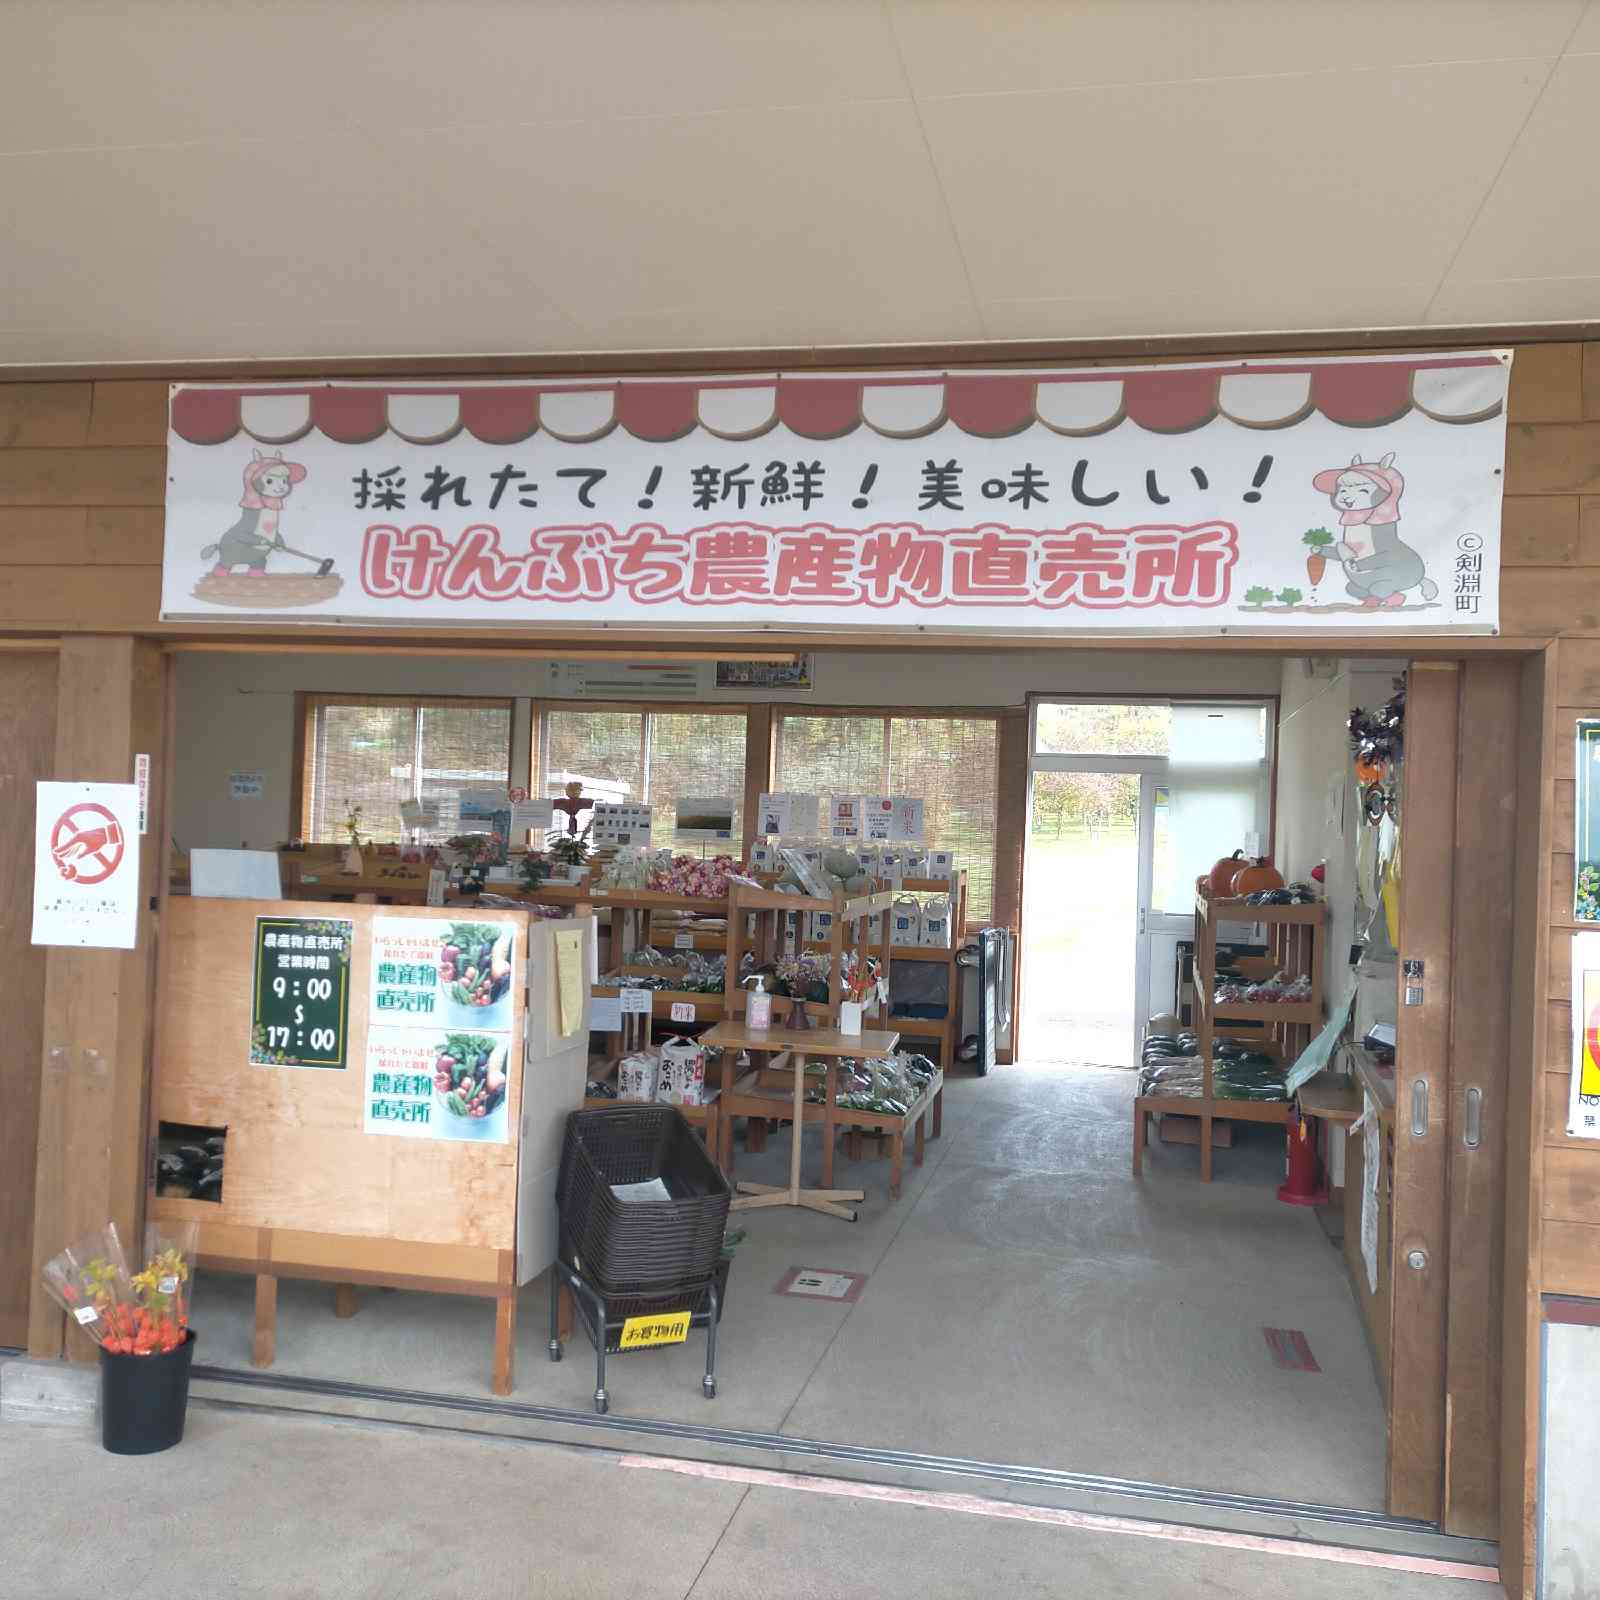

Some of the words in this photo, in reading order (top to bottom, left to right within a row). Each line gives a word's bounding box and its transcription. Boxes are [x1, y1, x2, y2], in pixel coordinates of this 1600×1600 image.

[361, 520, 1239, 608] けんぶち農産物直売所
[264, 933, 344, 951] 農産物直売所
[277, 954, 330, 970] 営業時間
[378, 962, 437, 987] 農産物
[376, 989, 435, 1014] 直売所
[373, 1073, 432, 1098] 農産物
[371, 1099, 431, 1124] 直売所
